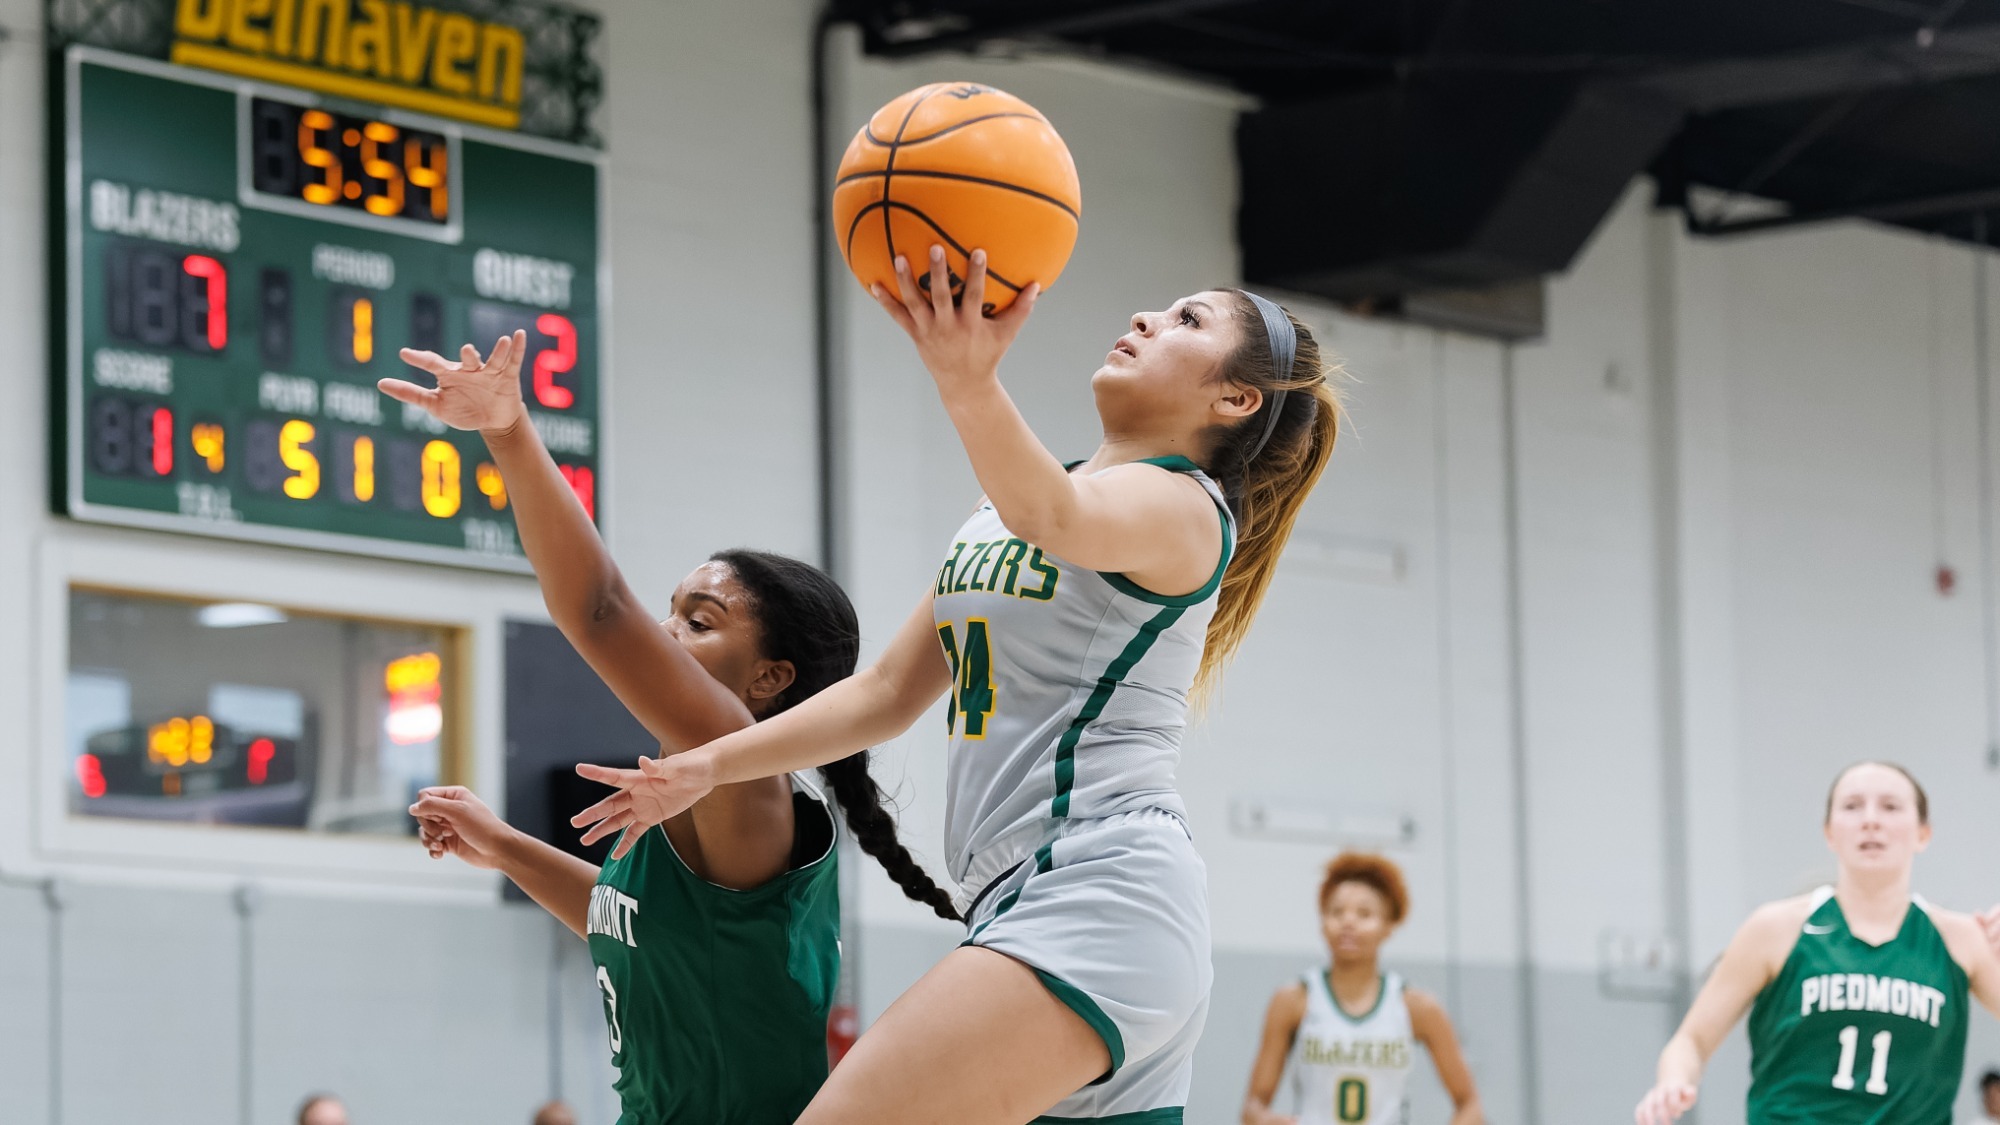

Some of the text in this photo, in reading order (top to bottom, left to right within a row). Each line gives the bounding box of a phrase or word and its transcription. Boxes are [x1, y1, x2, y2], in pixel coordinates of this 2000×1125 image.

[298, 109, 449, 220] 5:54
[91, 180, 240, 252] BLAZERS
[183, 254, 227, 349] 7
[473, 248, 574, 310] GUEST
[353, 298, 373, 363] 1
[533, 313, 578, 408] 2
[153, 408, 173, 476] 1
[279, 419, 320, 499] 5
[353, 434, 374, 502] 1
[421, 440, 461, 518] 0
[934, 537, 1060, 601] AZERS
[1801, 973, 1945, 1028] PIEDMONT
[1831, 1025, 1892, 1095] 11
[1335, 1075, 1369, 1124] 0
